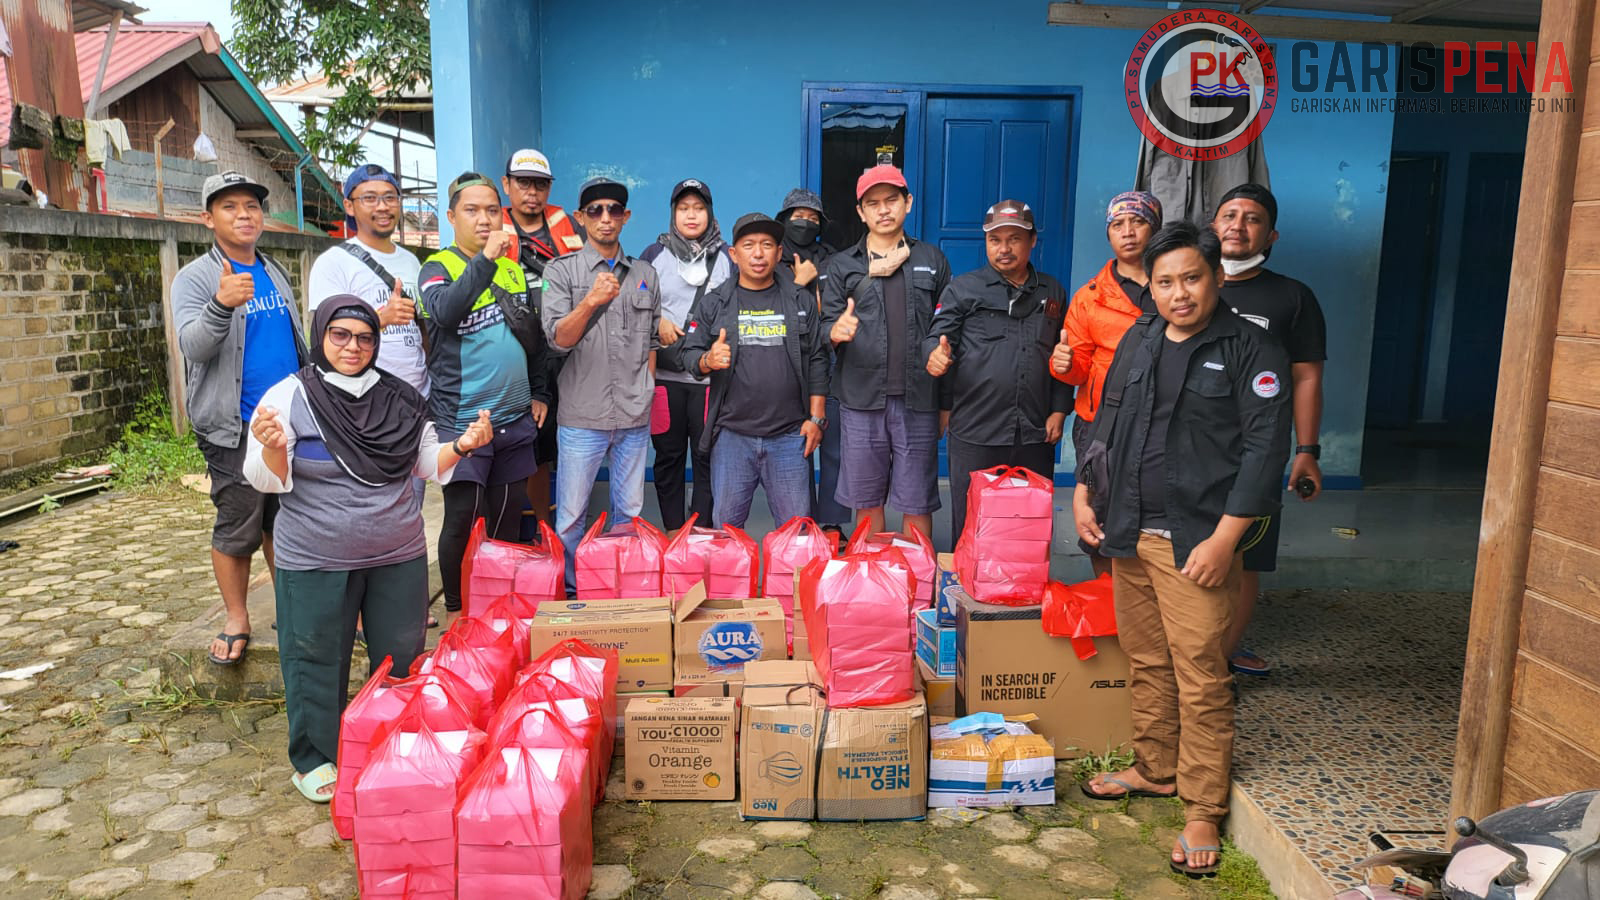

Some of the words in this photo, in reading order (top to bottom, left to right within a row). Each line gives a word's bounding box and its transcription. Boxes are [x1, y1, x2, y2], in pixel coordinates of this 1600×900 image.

[703, 631, 761, 647] AURA
[981, 674, 992, 687] IN
[996, 673, 1039, 687] SEARCH
[1042, 672, 1057, 685] OF
[1089, 679, 1126, 689] ASUS
[981, 687, 1047, 701] INCREDIBLE
[648, 753, 713, 770] Orange
[837, 763, 910, 779] HEALTH
[870, 776, 910, 791] NEO
[752, 801, 777, 811] Neo
